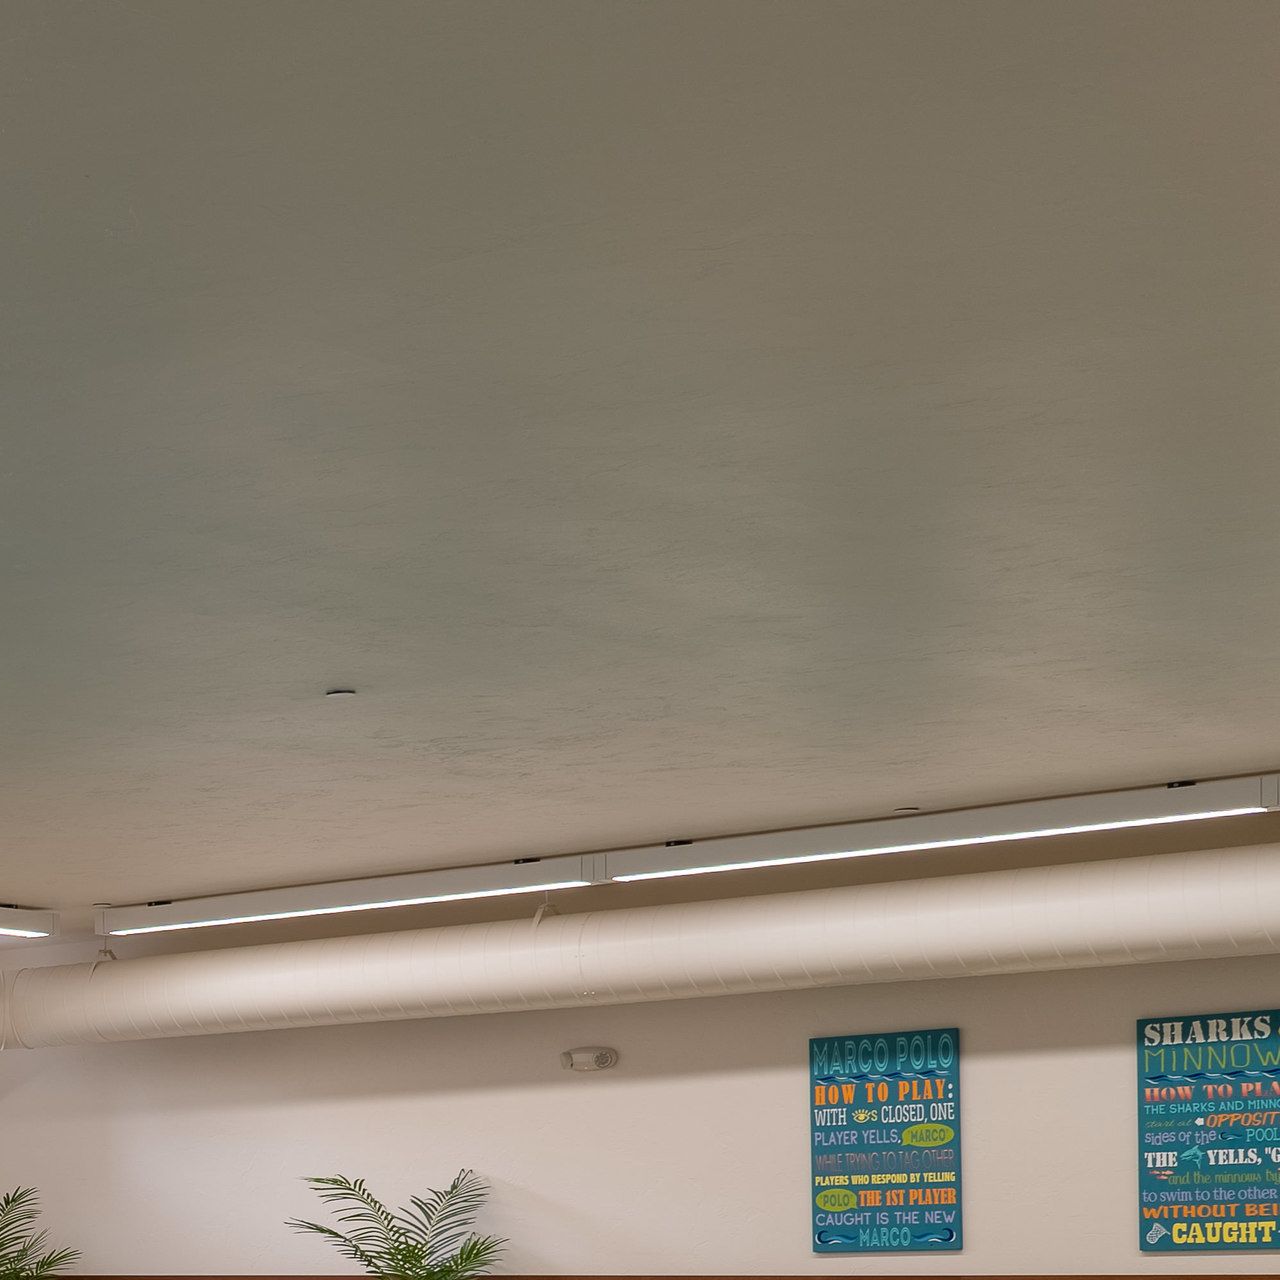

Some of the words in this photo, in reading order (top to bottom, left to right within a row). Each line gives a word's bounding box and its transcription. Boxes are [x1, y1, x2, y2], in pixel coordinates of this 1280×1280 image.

[1144, 1015, 1271, 1046] SHARKS
[813, 1039, 889, 1075] MARCO
[896, 1033, 954, 1070] POLO
[814, 1084, 856, 1105] HOW
[865, 1082, 889, 1103] TO
[898, 1079, 954, 1101] PLAY:
[1144, 1086, 1195, 1102] HOW
[1203, 1083, 1233, 1099] TO
[814, 1108, 847, 1126] WITH
[881, 1104, 928, 1124] CLOSED,
[930, 1102, 955, 1121] ONE
[1144, 1104, 1166, 1115] THE
[1169, 1102, 1216, 1114] SHARKS
[1219, 1101, 1244, 1111] AND
[814, 1131, 858, 1146] PLAYER
[862, 1129, 901, 1144] YELLS,
[1144, 1131, 1176, 1146] sides
[1178, 1131, 1192, 1145] of
[1195, 1130, 1217, 1145] the
[815, 1153, 843, 1172] WHILE
[845, 1152, 880, 1171] TRYING
[882, 1151, 896, 1170] TO
[899, 1150, 919, 1169] TAG
[922, 1149, 955, 1168] OTHER
[1144, 1151, 1178, 1168] THE
[1206, 1148, 1262, 1166] YELLS,
[815, 1175, 849, 1186] PLAYERS
[851, 1174, 868, 1185] WHO
[871, 1173, 908, 1184] RESPOND
[910, 1172, 920, 1183] BY
[923, 1171, 956, 1182] YELLING
[858, 1190, 882, 1207] THE
[885, 1189, 906, 1206] 1ST
[909, 1188, 957, 1205] PLAYER
[1142, 1190, 1157, 1203] to
[1160, 1188, 1192, 1202] swim
[1195, 1188, 1211, 1201] to
[1213, 1187, 1236, 1201] the
[815, 1212, 871, 1226] CAUGHT
[876, 1212, 889, 1225] IS
[894, 1211, 920, 1224] THE
[924, 1210, 956, 1224] NEW
[1142, 1203, 1240, 1219] WITHOUT
[859, 1227, 911, 1247] MARCO
[1172, 1220, 1276, 1244] CAUGHT
